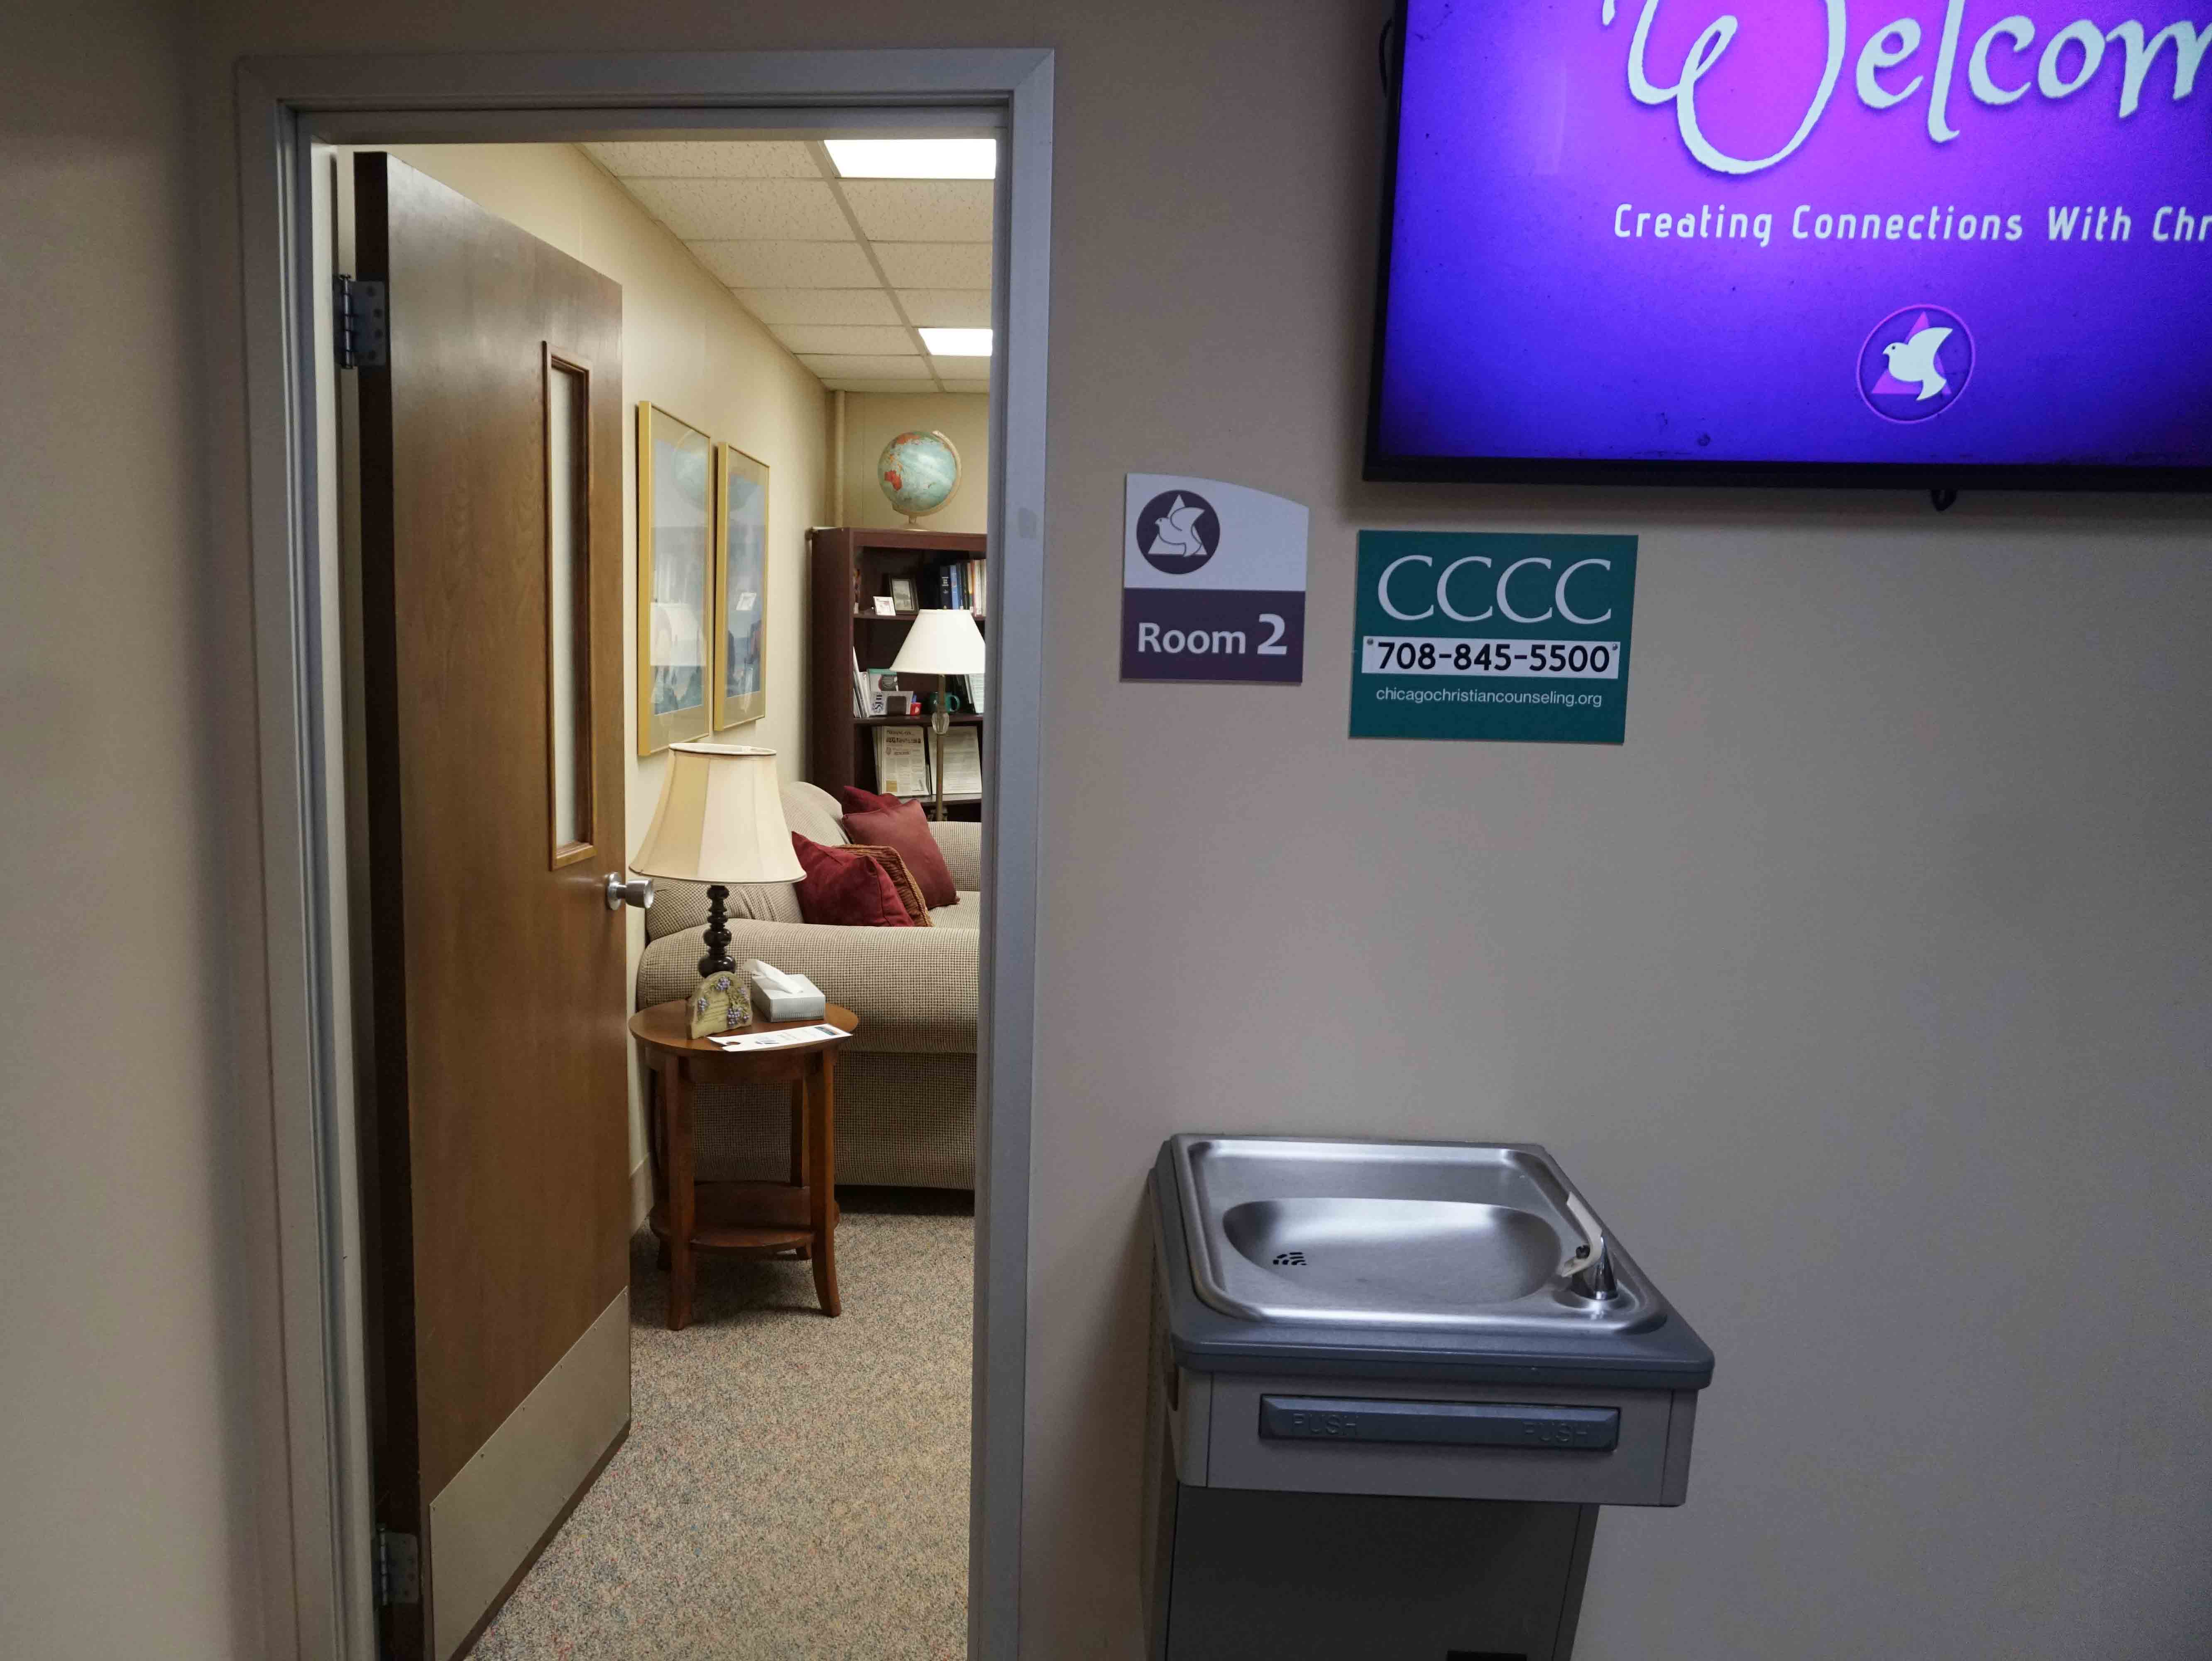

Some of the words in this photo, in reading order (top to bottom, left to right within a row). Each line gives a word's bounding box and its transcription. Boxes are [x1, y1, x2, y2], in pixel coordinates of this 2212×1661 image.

[1614, 203, 1773, 248] Creating
[1792, 204, 2023, 241] Connections
[2048, 205, 2131, 241] With
[1378, 554, 1612, 624] CCCC
[1138, 622, 1246, 654] Room
[1257, 613, 1287, 655] 2
[1377, 642, 1610, 673] 708-845-5500
[1376, 687, 1603, 708] chicagochristiancounseling.org
[1292, 1412, 1359, 1436] PUSH
[1522, 1421, 1590, 1445] PUSH
